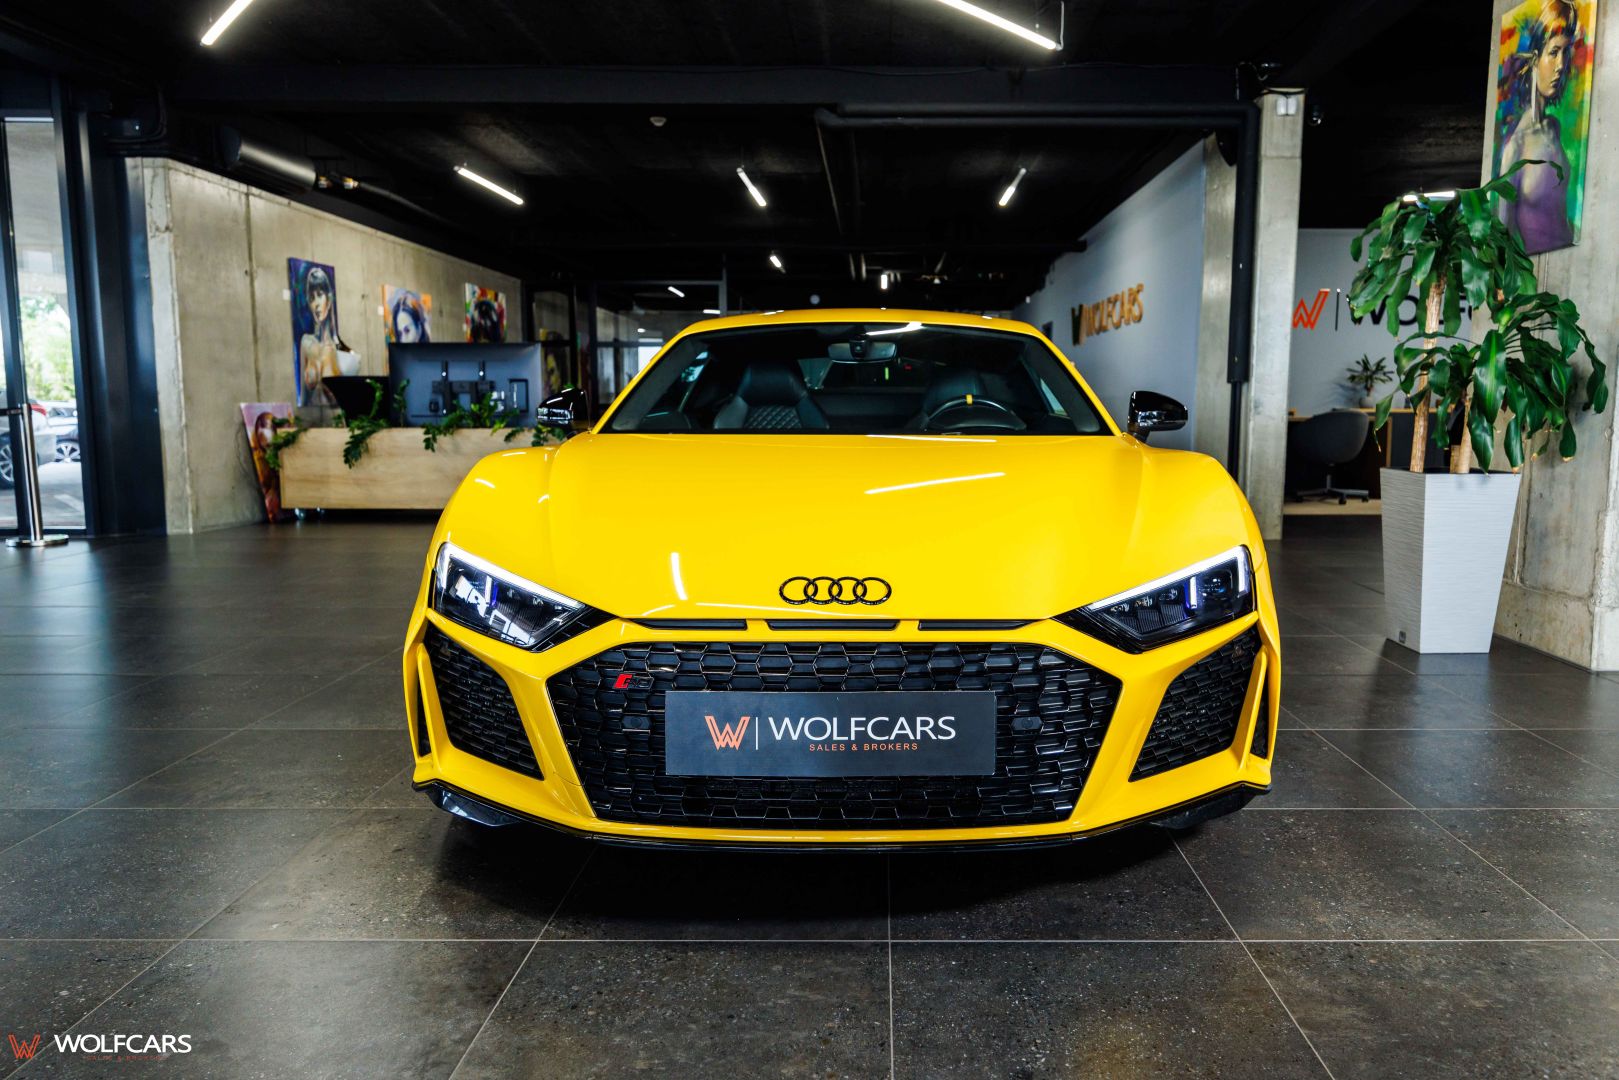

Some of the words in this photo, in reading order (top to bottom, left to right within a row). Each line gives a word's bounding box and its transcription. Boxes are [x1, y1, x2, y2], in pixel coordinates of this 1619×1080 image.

[768, 716, 956, 741] WOLFCARS
[809, 743, 846, 752] SALES
[851, 743, 858, 751] &
[863, 743, 918, 751] BROKERS
